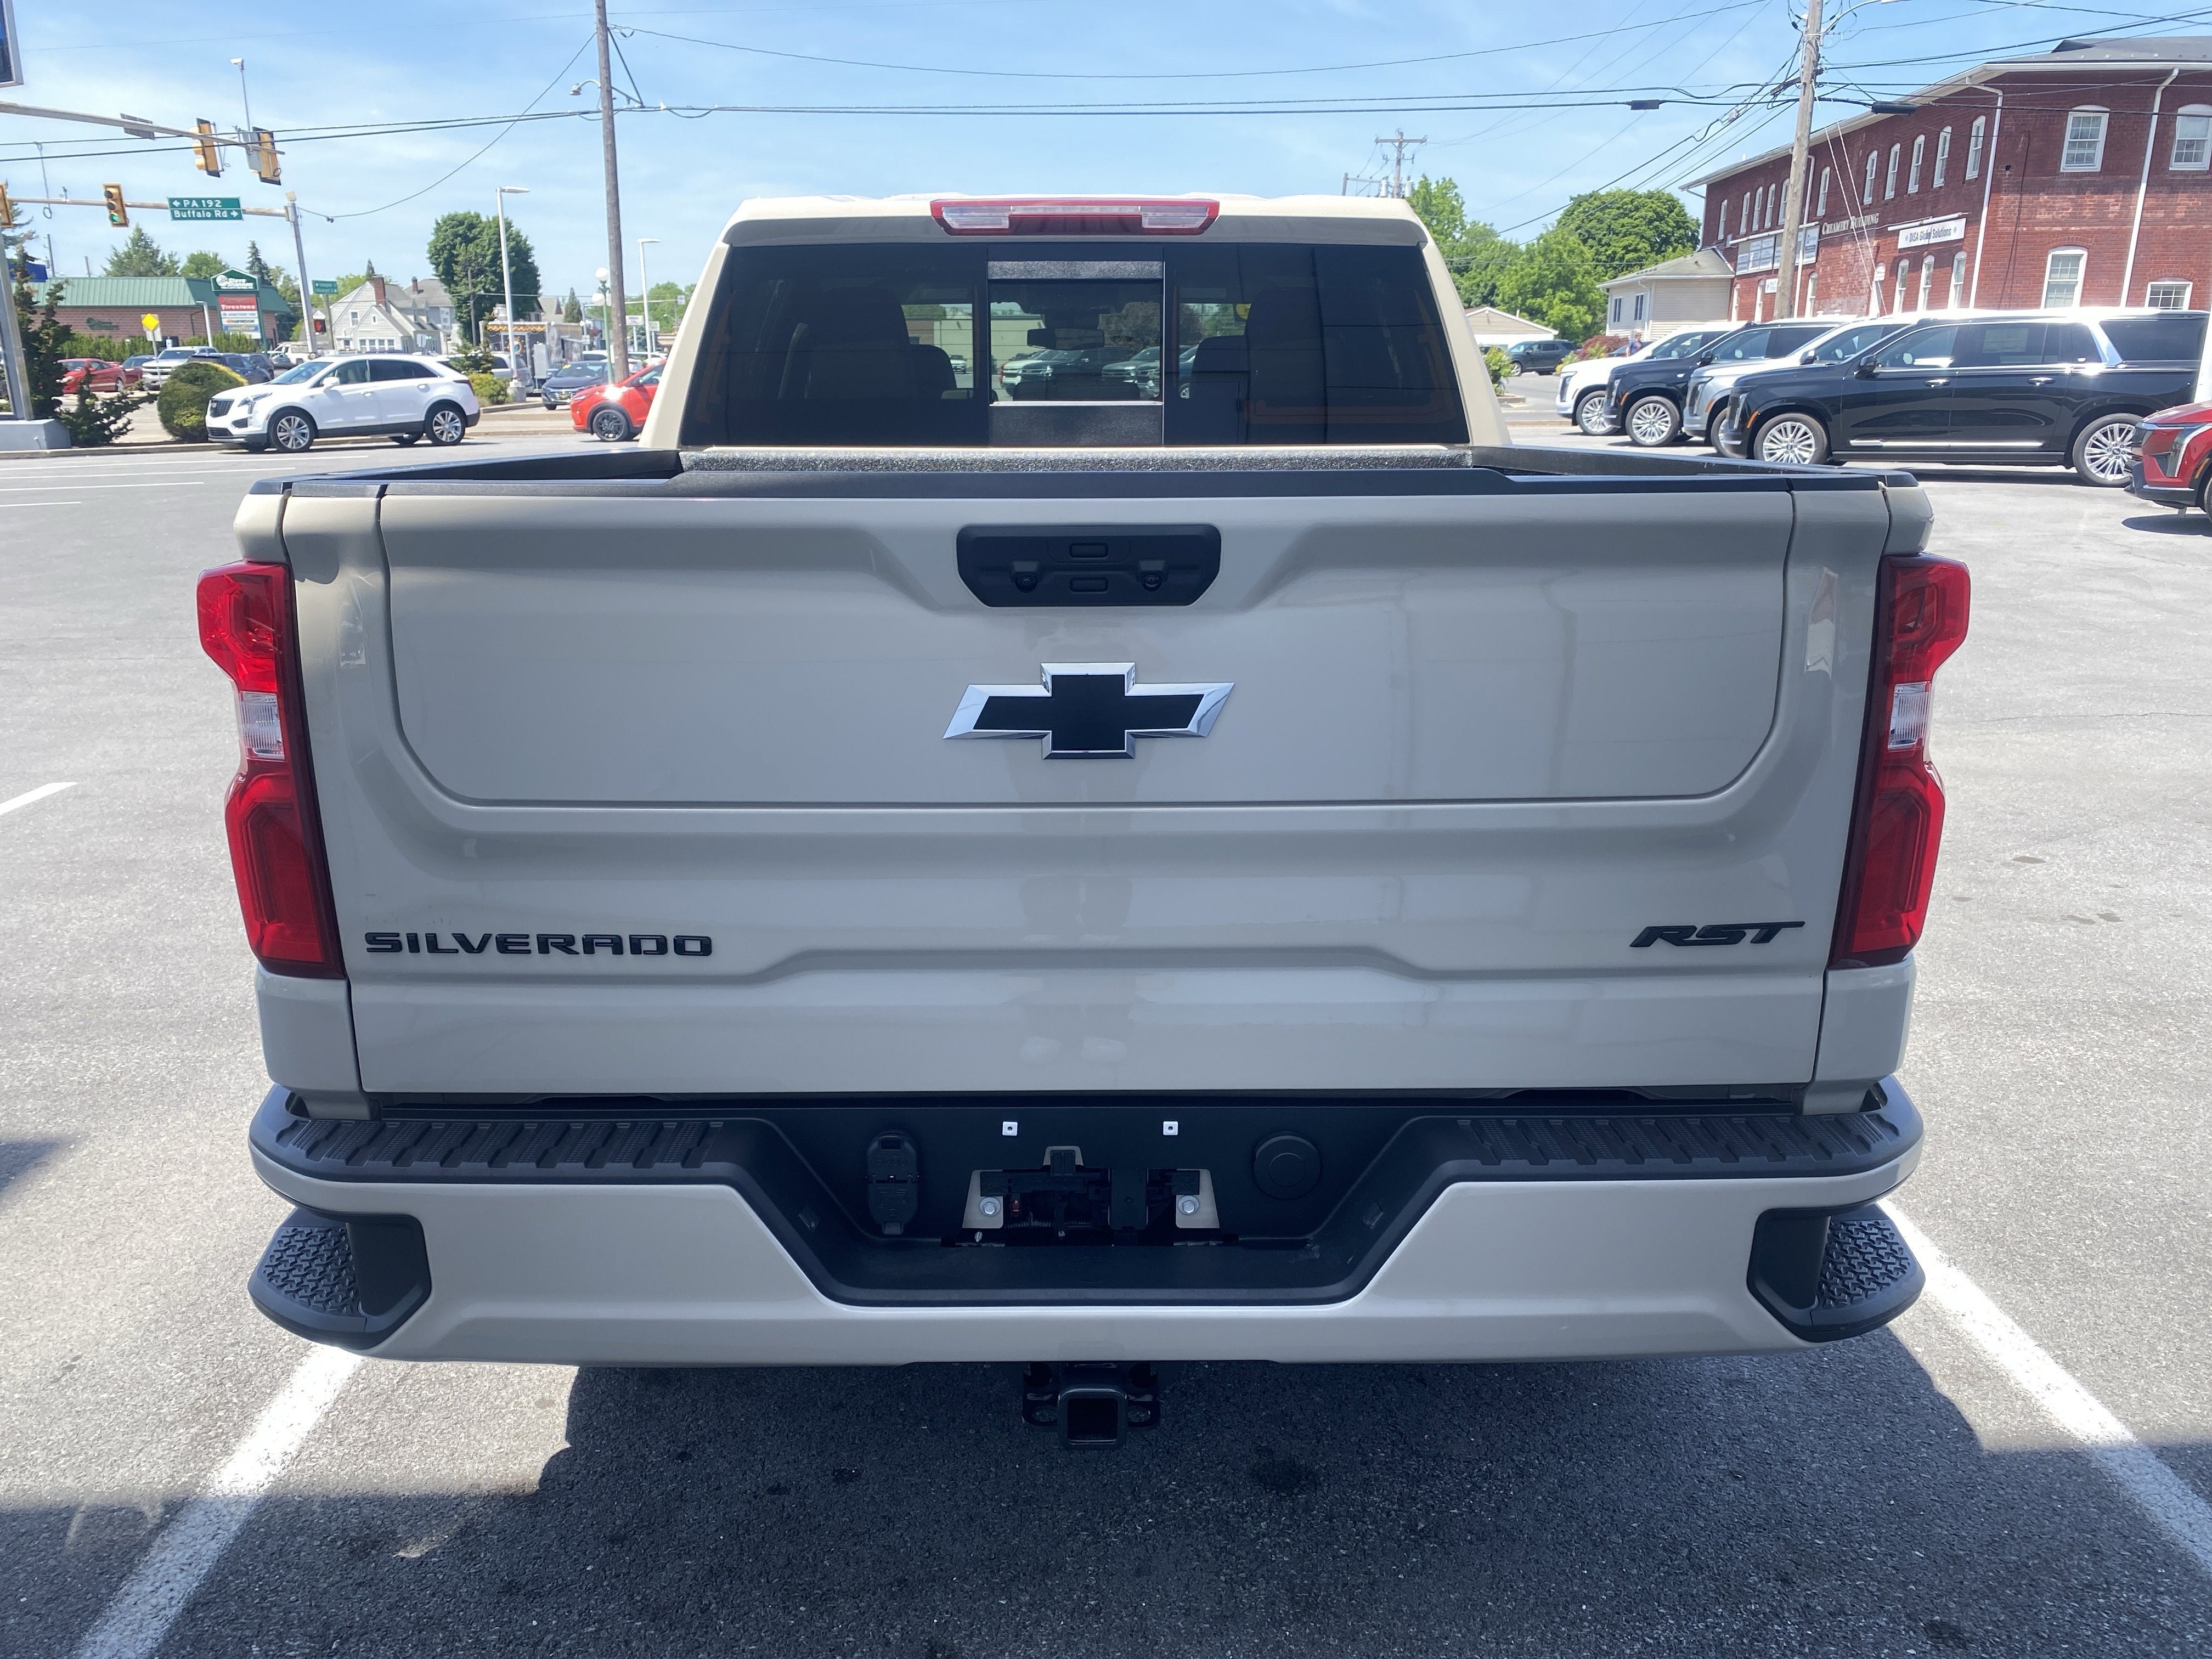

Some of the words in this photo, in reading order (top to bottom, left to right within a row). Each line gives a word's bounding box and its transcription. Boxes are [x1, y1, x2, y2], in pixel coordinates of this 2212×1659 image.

[214, 210, 228, 218] Rd
[1909, 232, 1919, 242] DISA
[1919, 229, 1932, 241] Global
[1932, 227, 1951, 239] Solutions
[1629, 921, 1805, 947] RST
[364, 932, 713, 957] SILVERADO
